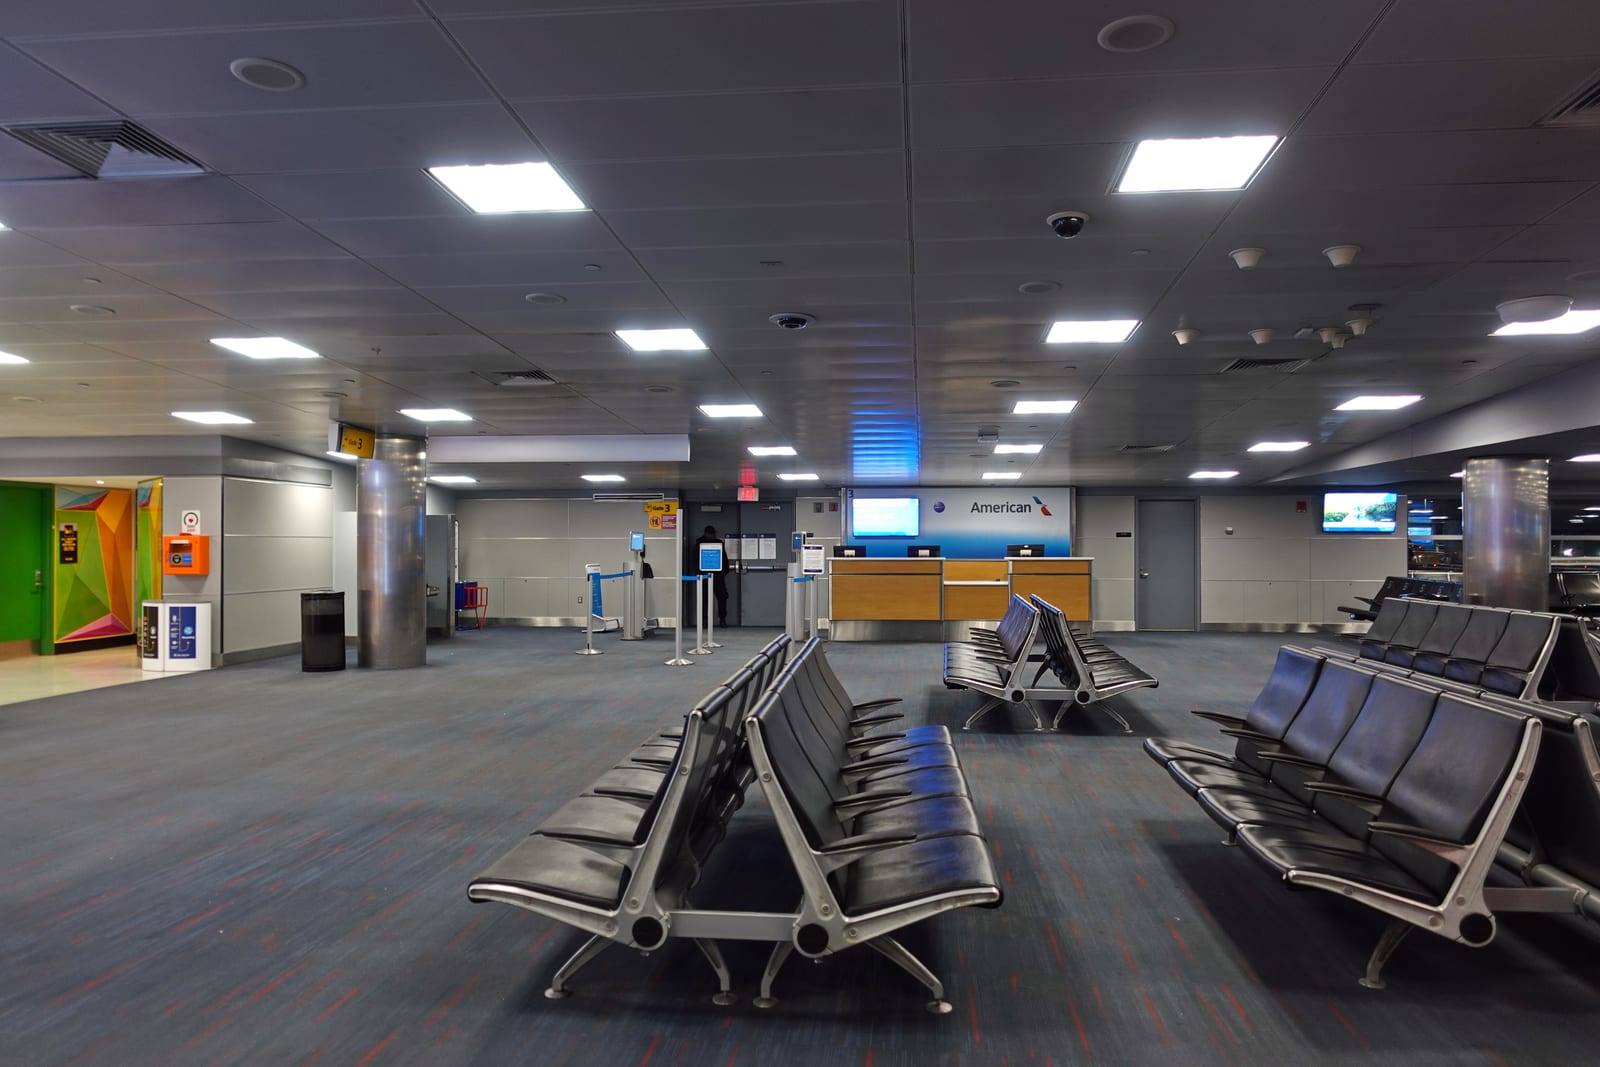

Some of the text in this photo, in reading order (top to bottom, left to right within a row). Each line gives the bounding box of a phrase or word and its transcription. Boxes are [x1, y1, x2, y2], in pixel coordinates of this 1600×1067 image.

[357, 438, 363, 450] 3
[848, 489, 854, 499] 3
[665, 504, 670, 512] 3
[970, 501, 1032, 513] American
